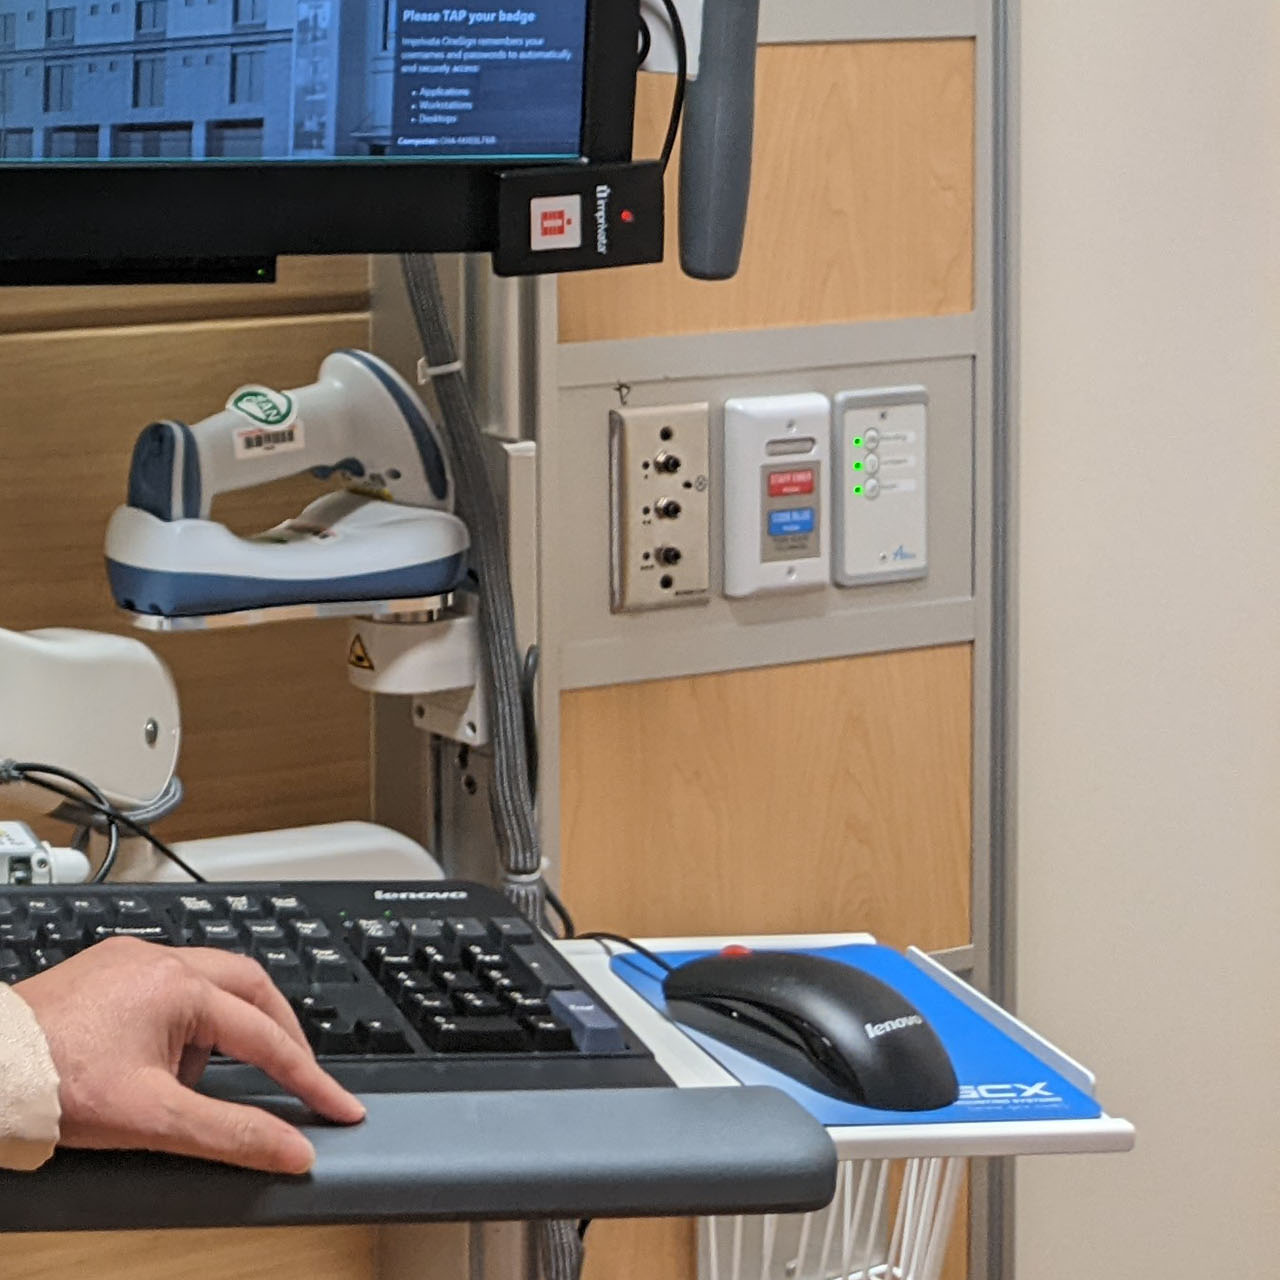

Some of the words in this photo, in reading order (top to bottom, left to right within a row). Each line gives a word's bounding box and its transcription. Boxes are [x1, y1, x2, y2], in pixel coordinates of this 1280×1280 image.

[403, 9, 441, 22] Please
[442, 9, 467, 22] TAP
[468, 11, 496, 25] your
[498, 9, 537, 25] badge
[373, 889, 468, 901] lenovo
[864, 1014, 923, 1039] lenovo
